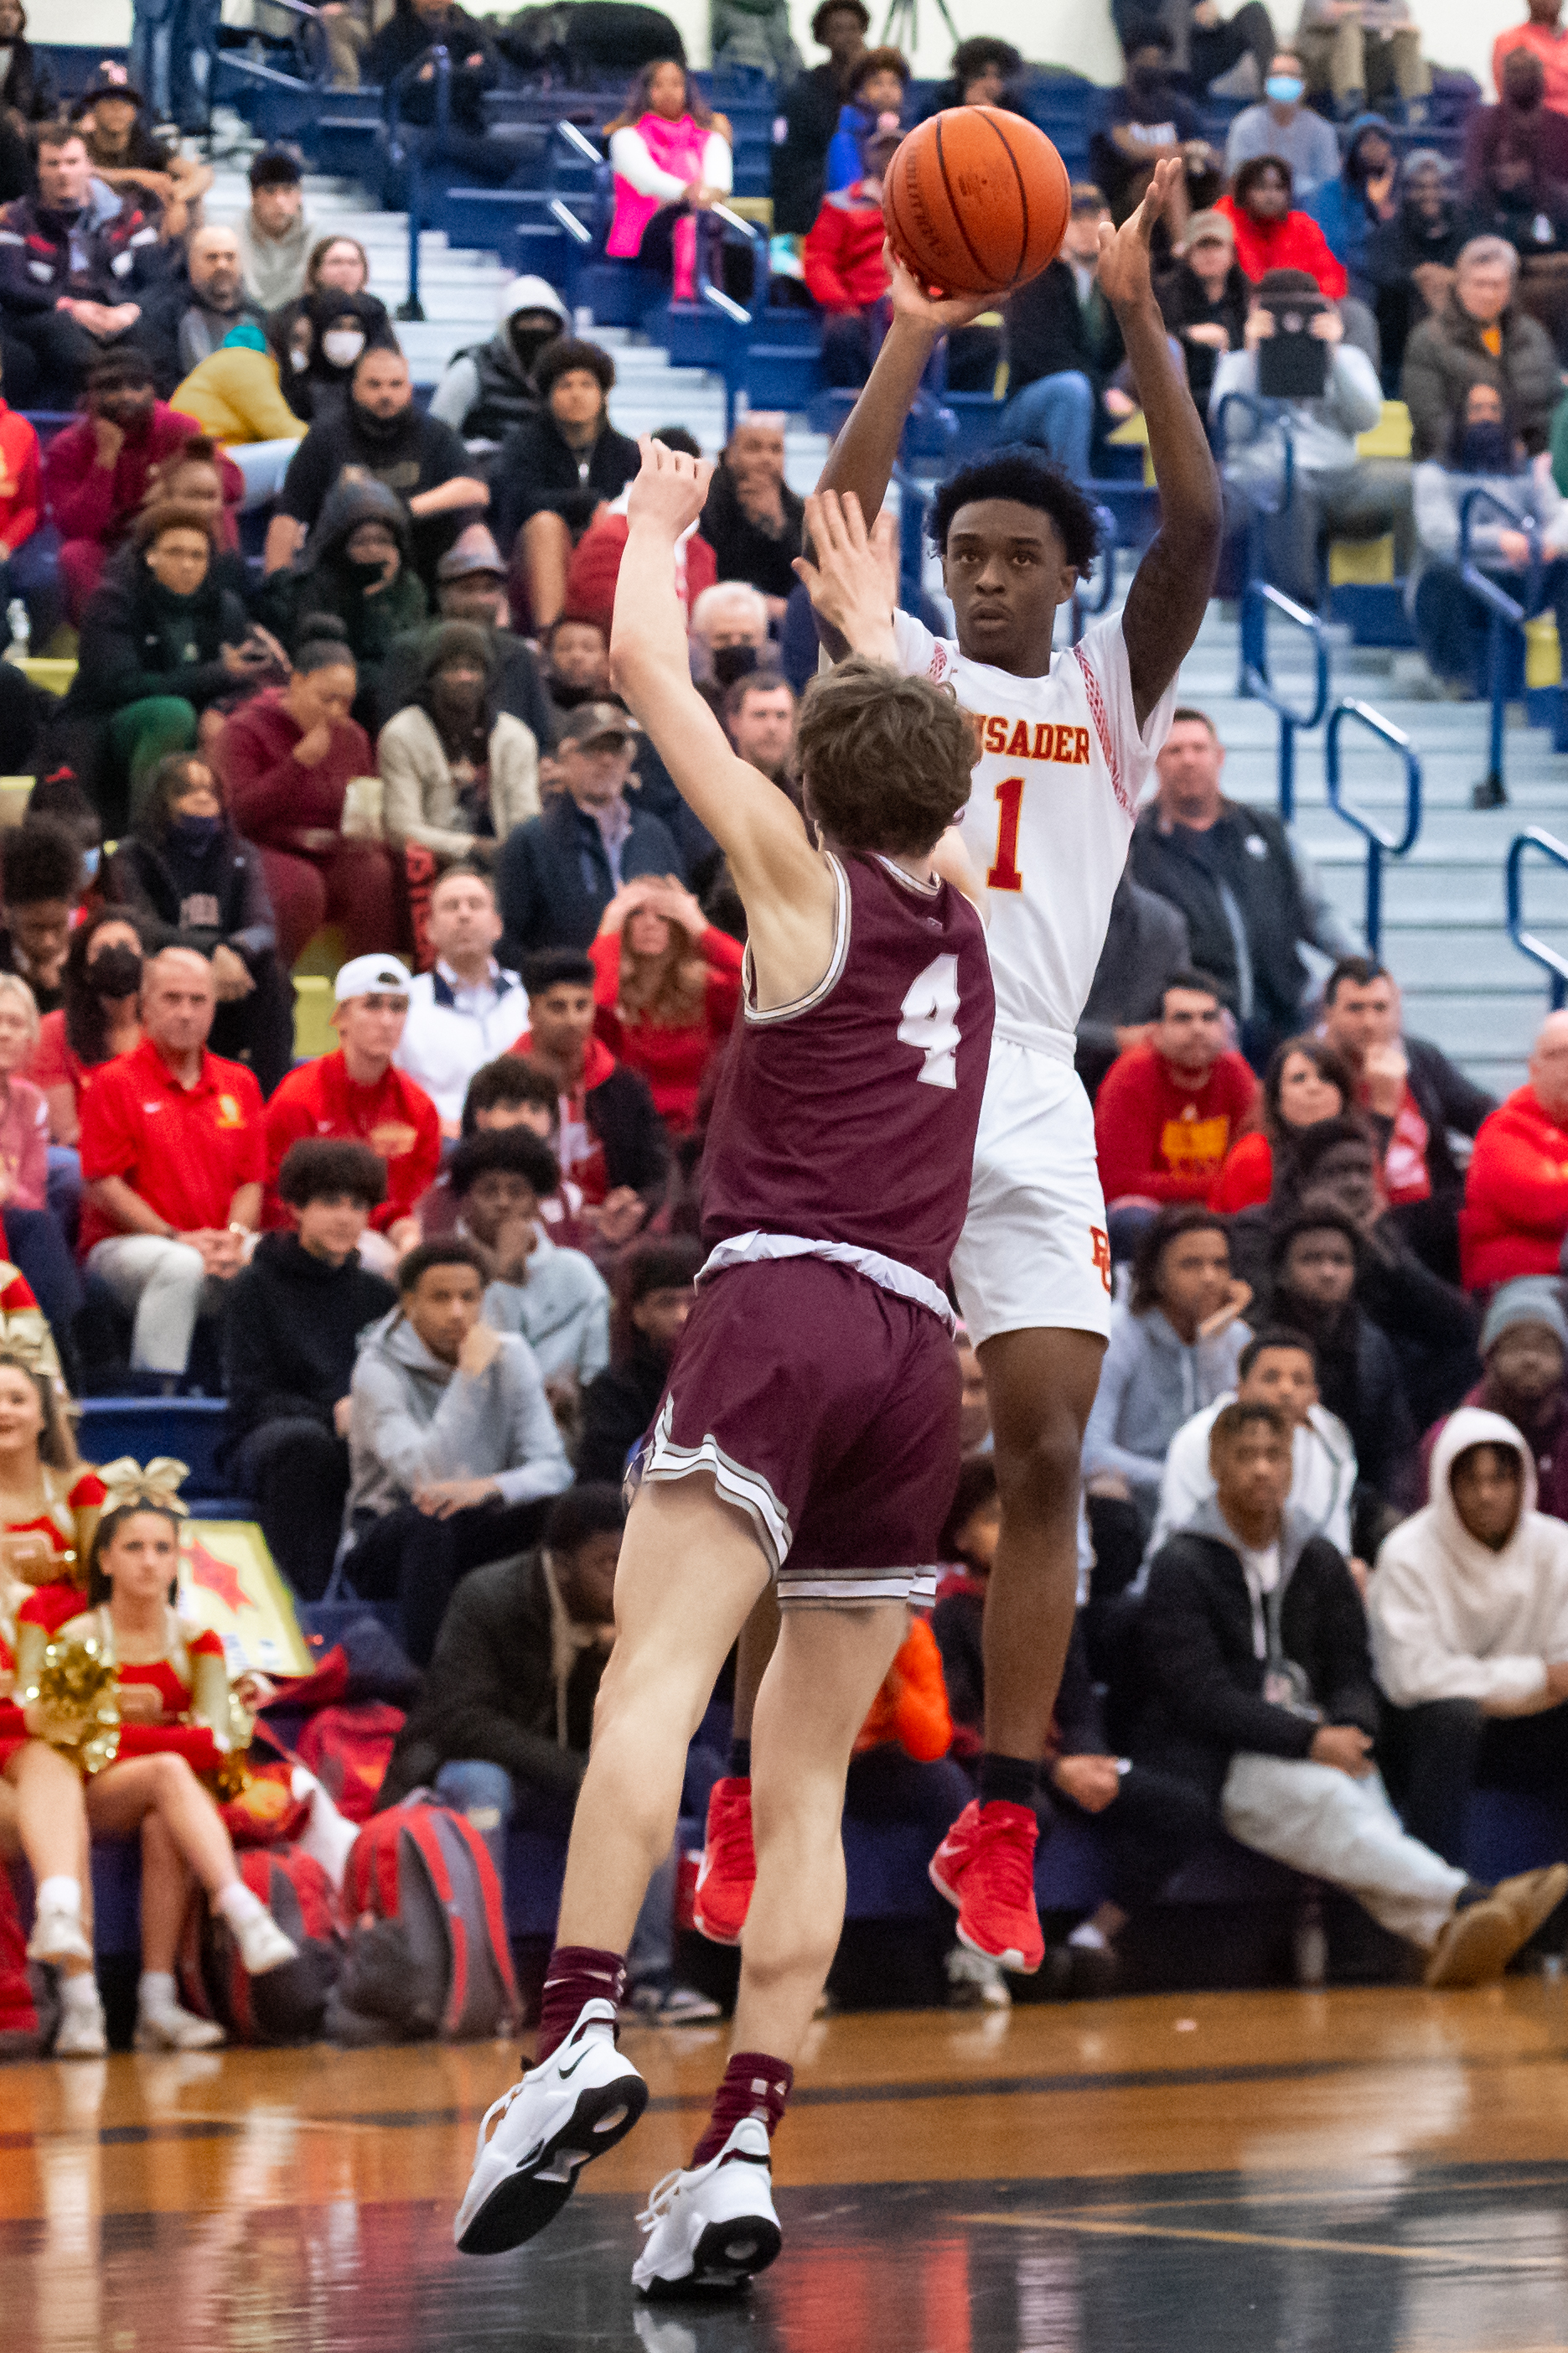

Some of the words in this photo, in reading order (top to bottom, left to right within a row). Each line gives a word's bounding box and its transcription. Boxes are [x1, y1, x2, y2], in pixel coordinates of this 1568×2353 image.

[973, 713, 1089, 765] SADER
[986, 775, 1025, 893] 1
[897, 952, 962, 1090] 4
